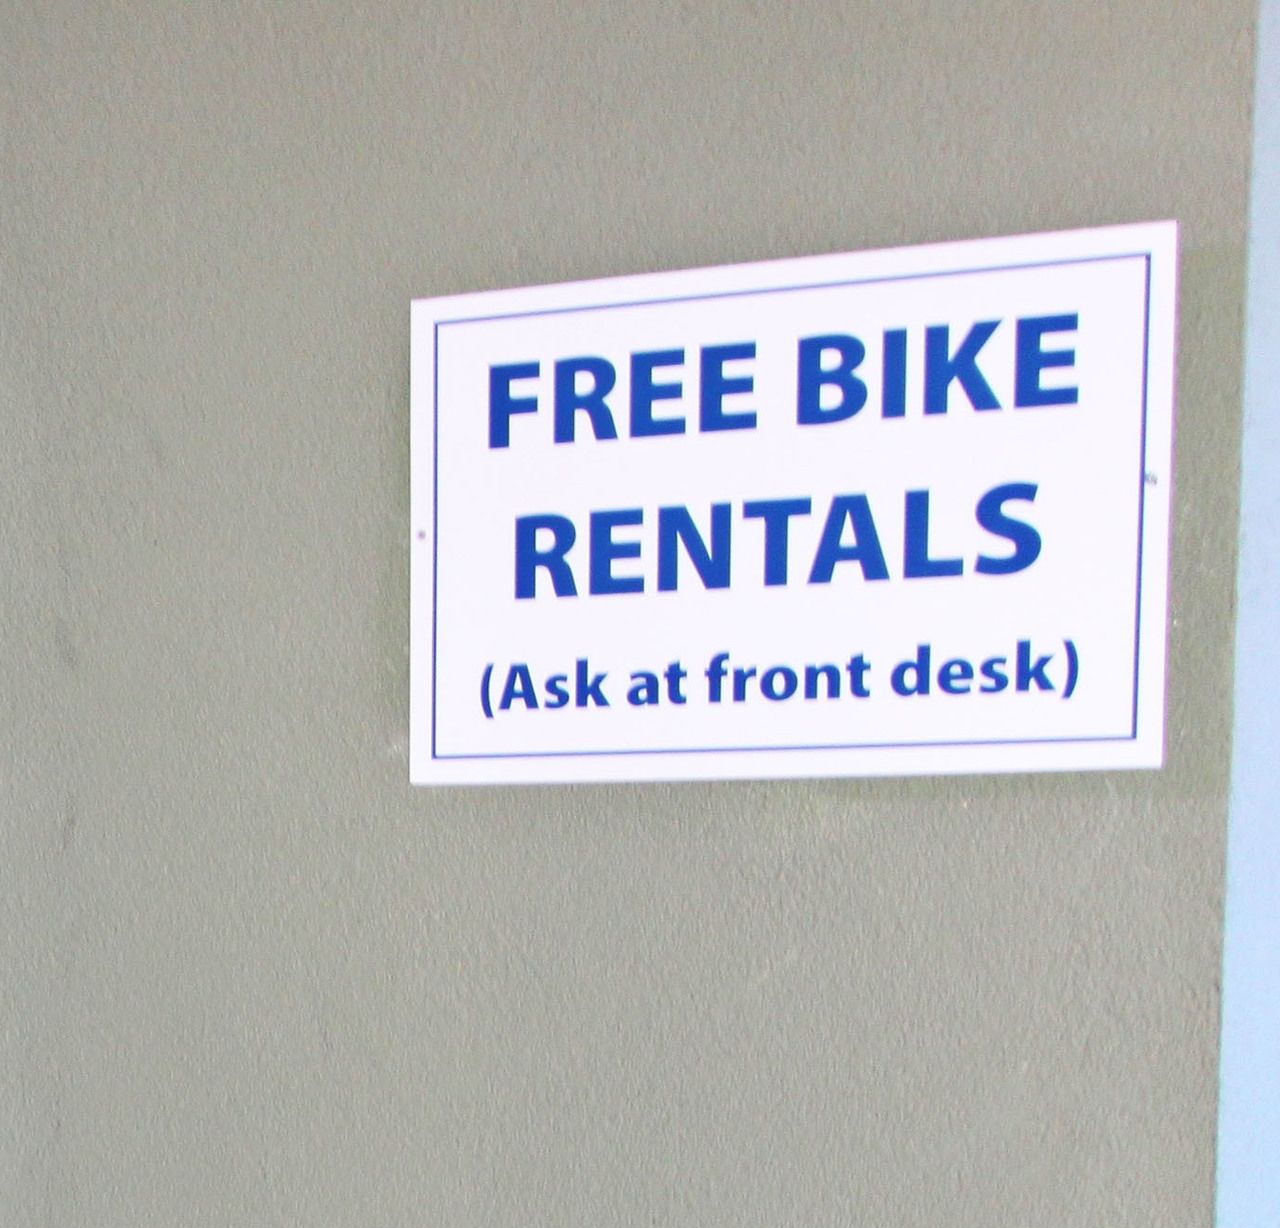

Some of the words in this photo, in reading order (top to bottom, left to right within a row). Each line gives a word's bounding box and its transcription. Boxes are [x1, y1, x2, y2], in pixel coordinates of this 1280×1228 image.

[488, 341, 758, 449] FREE
[796, 312, 1079, 426] BIKE
[515, 482, 1042, 600] RENTALS
[480, 658, 609, 719] (Ask
[627, 661, 688, 706] at
[704, 652, 872, 704] front
[891, 639, 1079, 699] desk)
